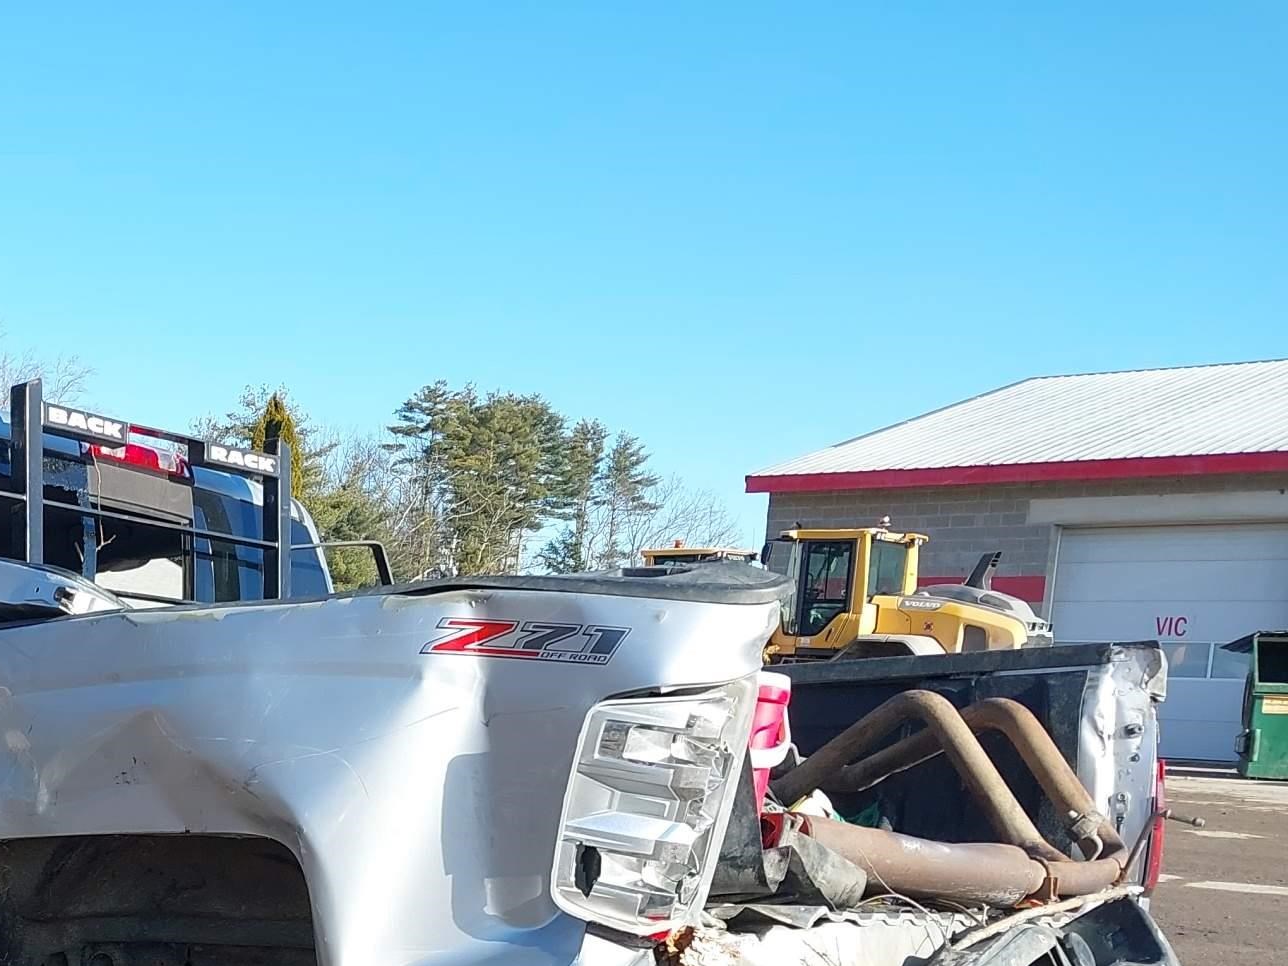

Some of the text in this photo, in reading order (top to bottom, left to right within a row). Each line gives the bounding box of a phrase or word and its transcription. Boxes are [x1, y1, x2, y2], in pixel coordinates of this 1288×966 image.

[48, 406, 276, 472] BACK RACK
[903, 600, 941, 609] VOLVO
[1156, 616, 1187, 637] VIC
[420, 617, 632, 658] Z71
[540, 651, 608, 663] OFF ROAD
